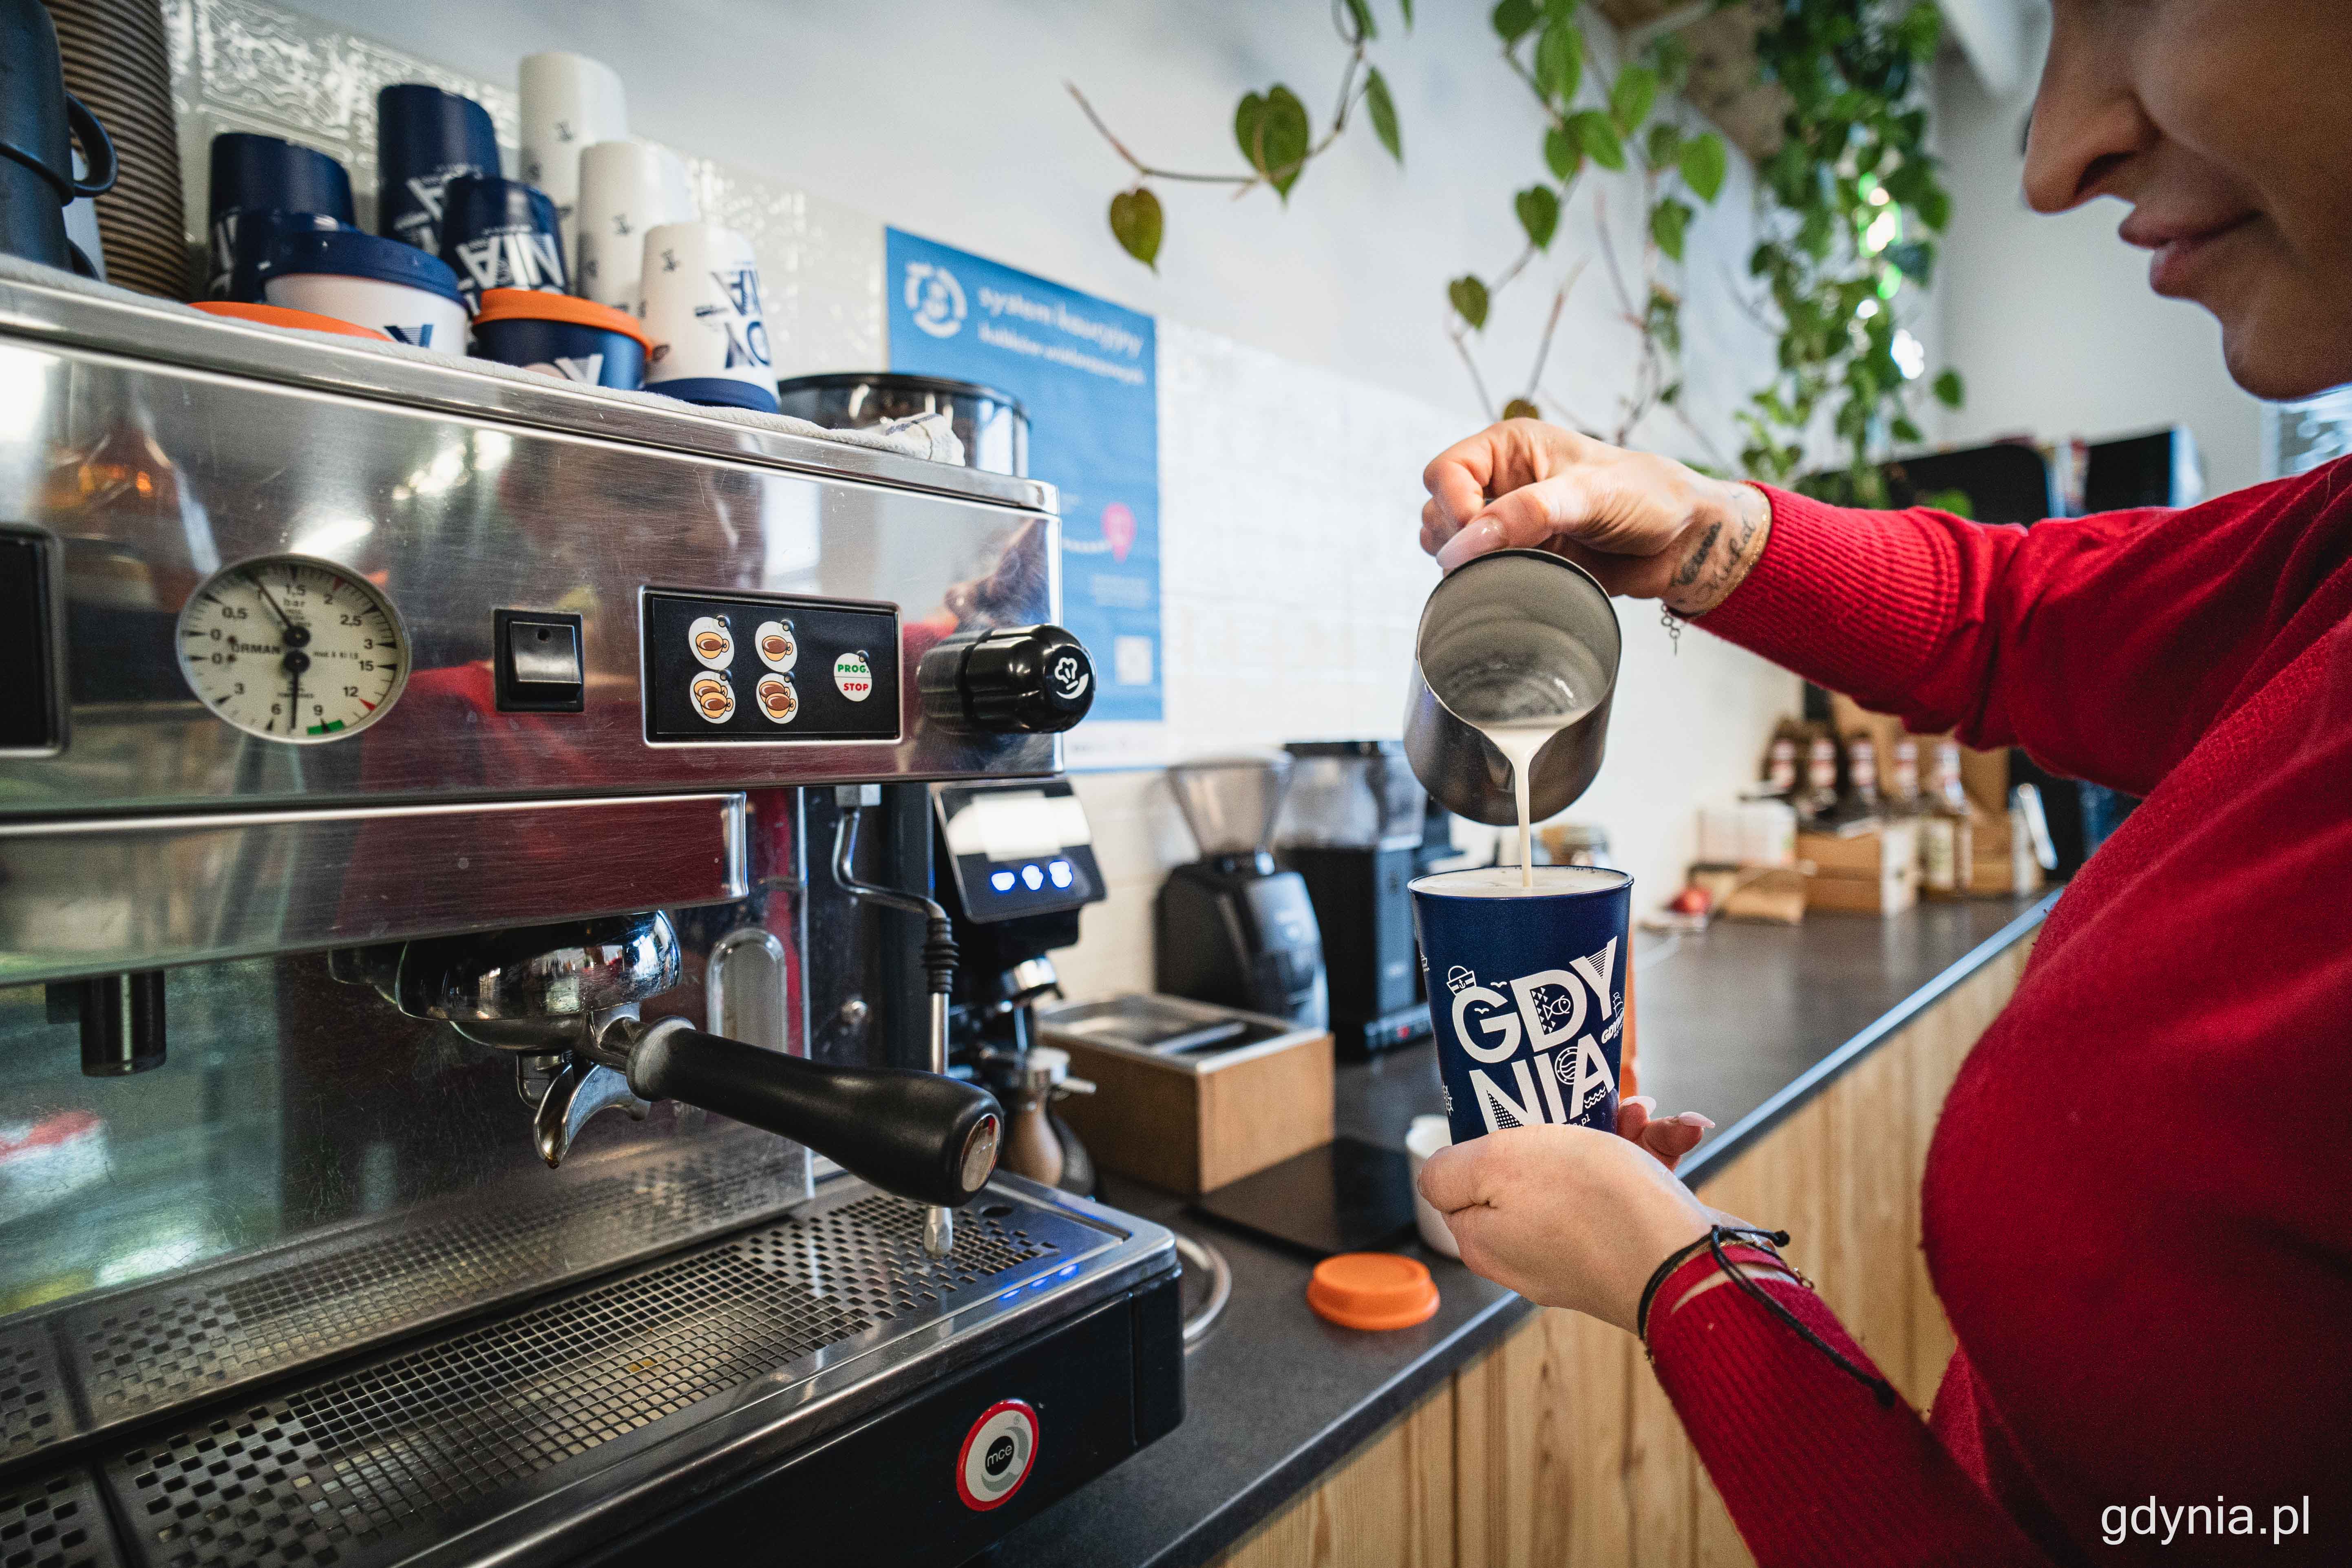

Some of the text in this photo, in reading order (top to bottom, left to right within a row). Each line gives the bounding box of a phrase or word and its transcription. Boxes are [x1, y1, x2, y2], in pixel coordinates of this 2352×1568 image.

[323, 594, 333, 605] 2
[210, 628, 221, 641] 0
[364, 638, 373, 649] 3
[212, 652, 223, 665] 0
[359, 660, 374, 671] 15
[837, 665, 869, 673] PROG.
[234, 682, 244, 695] 3
[343, 686, 359, 698] 12
[844, 683, 868, 691] STOP
[271, 703, 281, 715] 6
[313, 704, 323, 716] 9
[1452, 936, 1617, 1063] GDY
[1469, 1033, 1615, 1135] NIA
[987, 1445, 1012, 1467] mce
